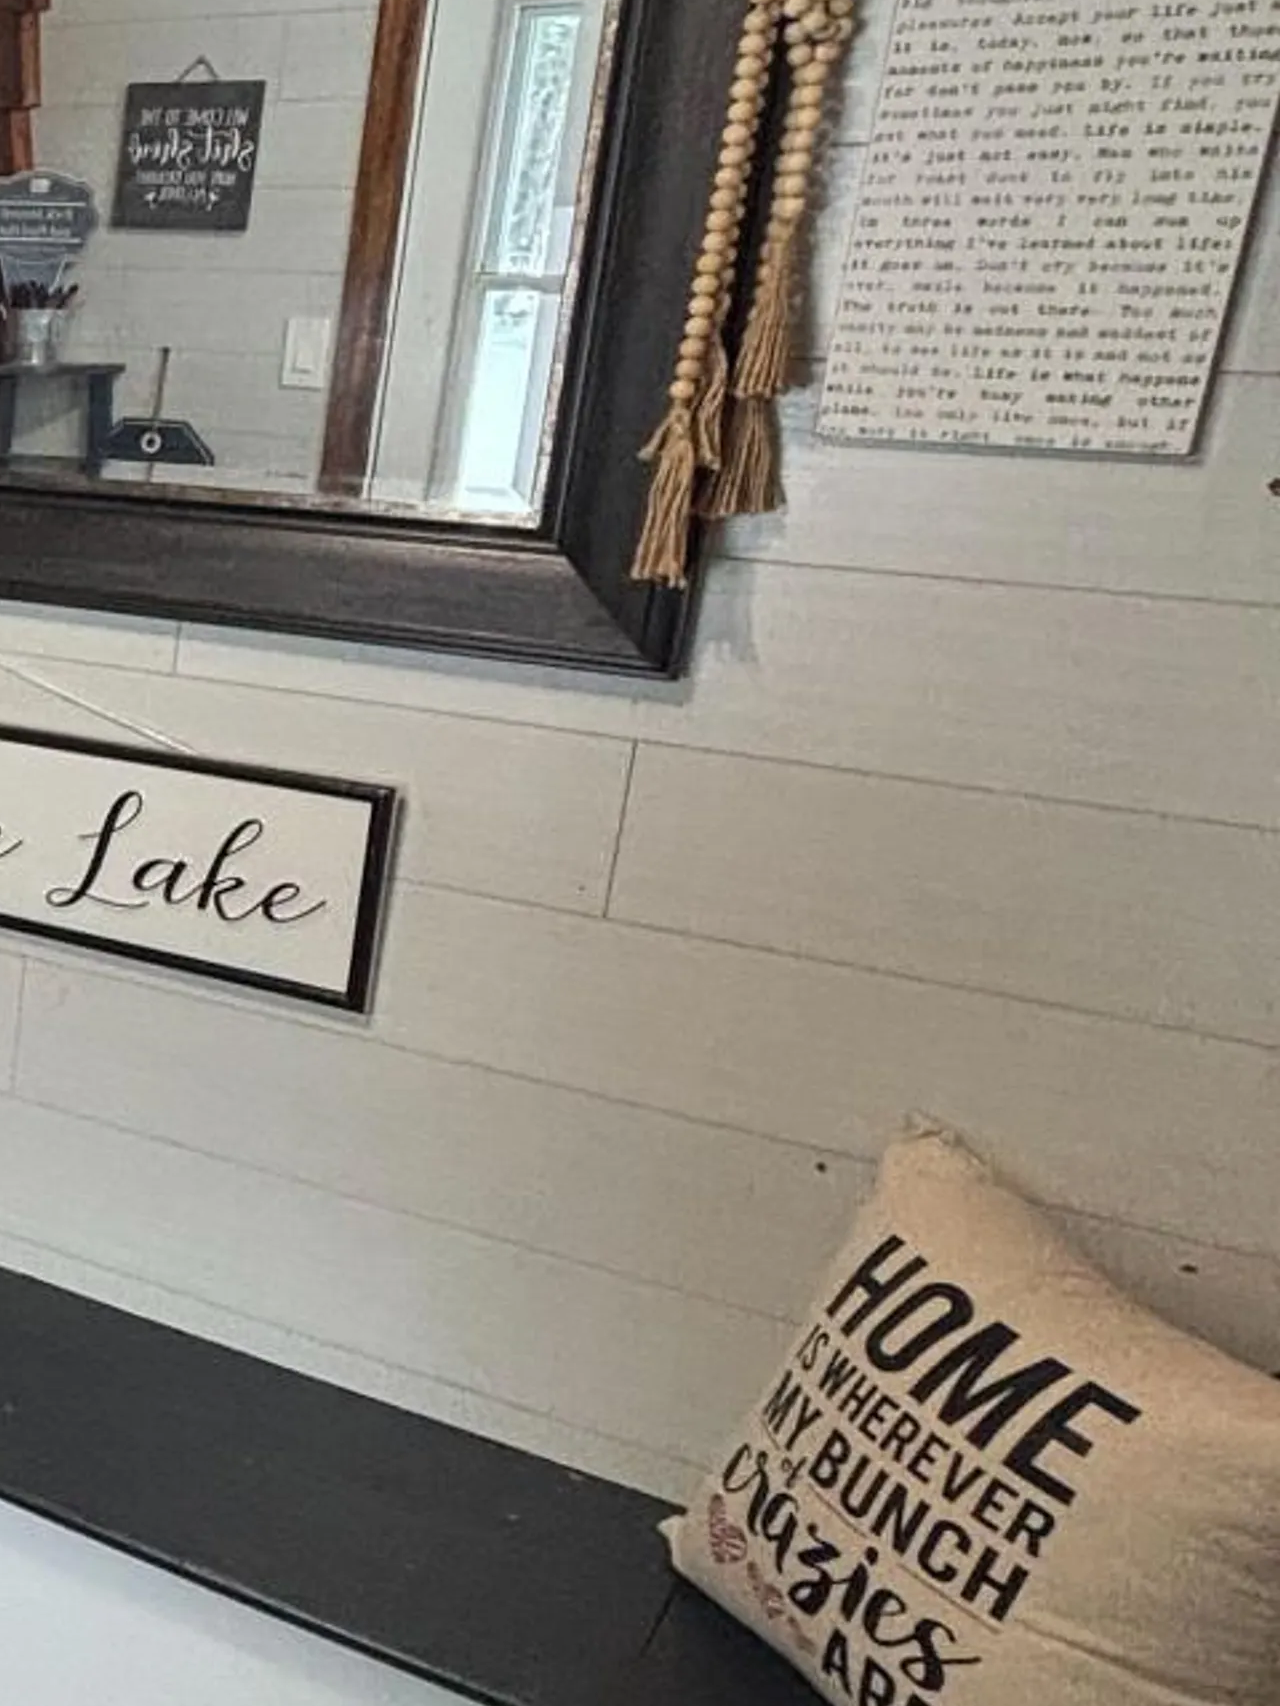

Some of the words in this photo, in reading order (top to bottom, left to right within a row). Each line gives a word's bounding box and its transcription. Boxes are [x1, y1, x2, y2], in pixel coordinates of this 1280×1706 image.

[46, 790, 328, 924] Lake
[796, 1325, 828, 1376] IS
[817, 1347, 1060, 1557] WHEREVER
[826, 1233, 1142, 1507] HOME
[722, 1444, 983, 1693] crazies
[761, 1371, 823, 1450] MY
[807, 1429, 1029, 1622] BUNCH
